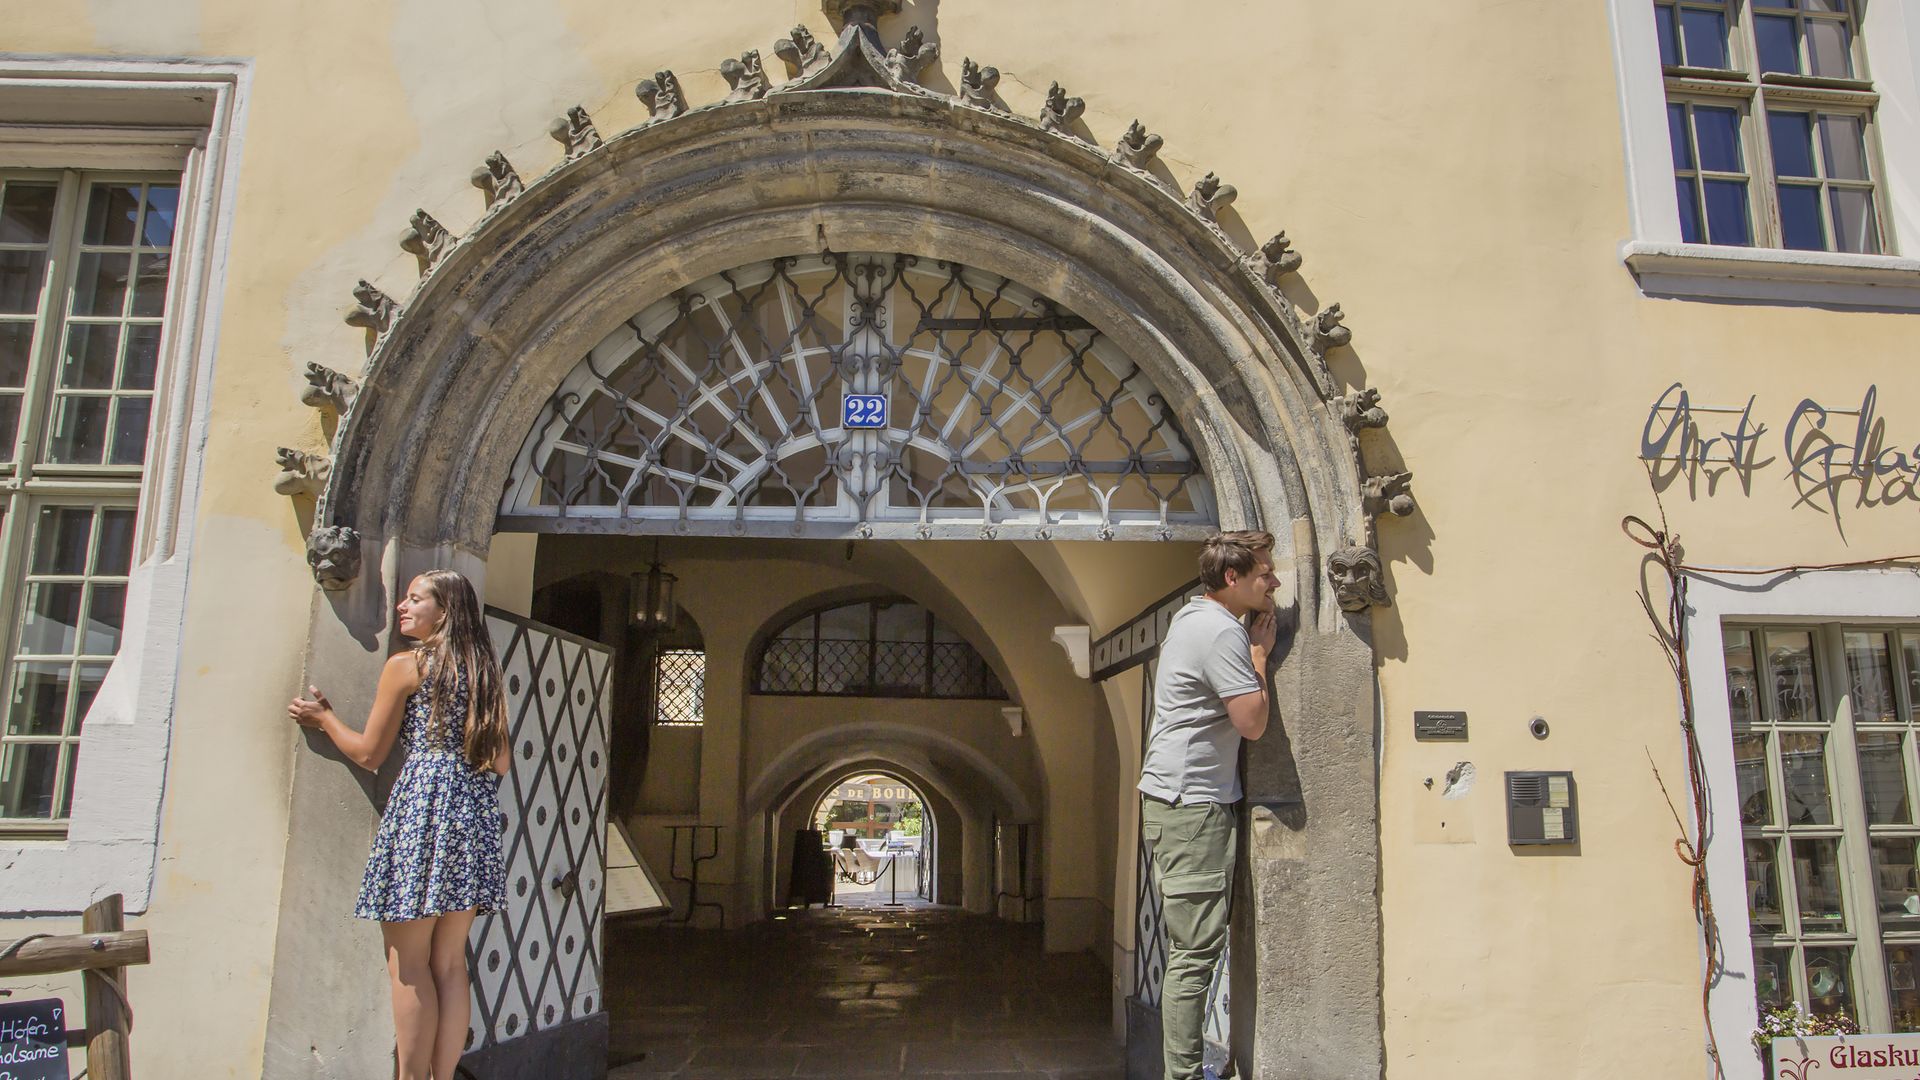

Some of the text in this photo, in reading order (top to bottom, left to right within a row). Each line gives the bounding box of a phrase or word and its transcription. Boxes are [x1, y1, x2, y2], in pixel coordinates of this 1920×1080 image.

[847, 398, 883, 424] 22
[1640, 381, 1768, 471] Art
[847, 789, 864, 798] DE
[1830, 1044, 1919, 1068] Glasku
